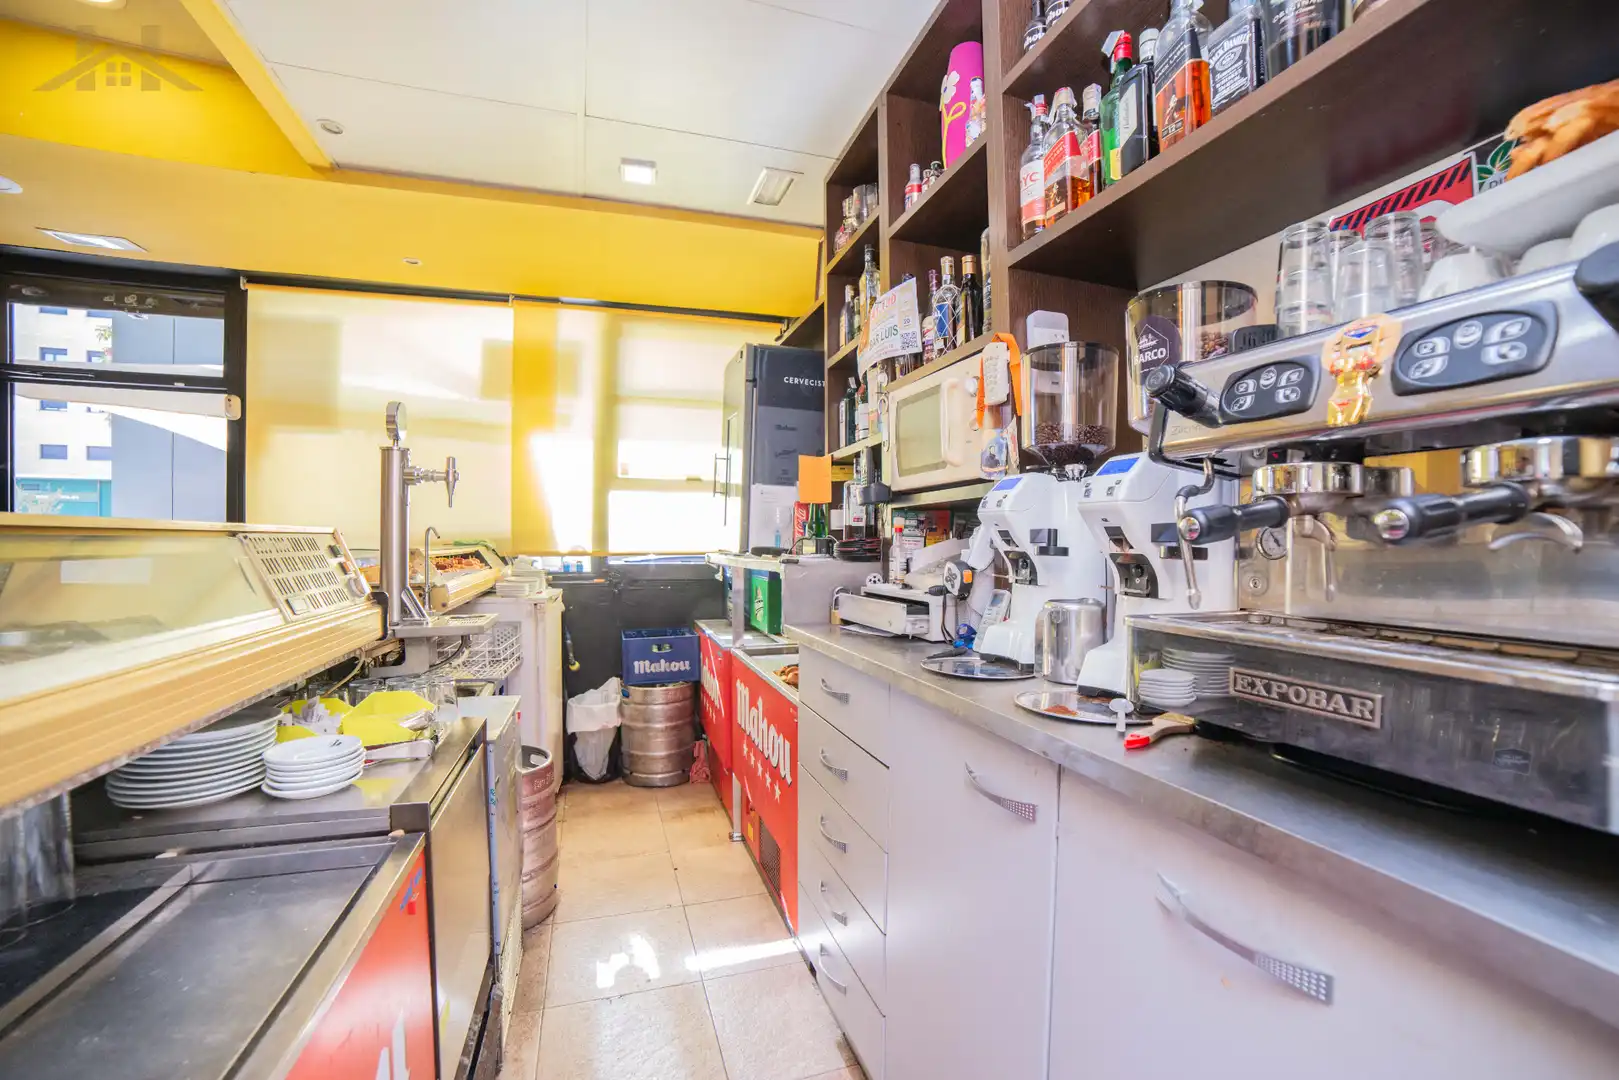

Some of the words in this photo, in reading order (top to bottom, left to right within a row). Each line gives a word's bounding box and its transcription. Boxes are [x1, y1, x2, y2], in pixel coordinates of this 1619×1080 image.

[880, 324, 899, 341] LUIS
[633, 658, 691, 675] Mahou
[1233, 673, 1375, 720] EXPOBAR
[735, 678, 793, 786] Mahou
